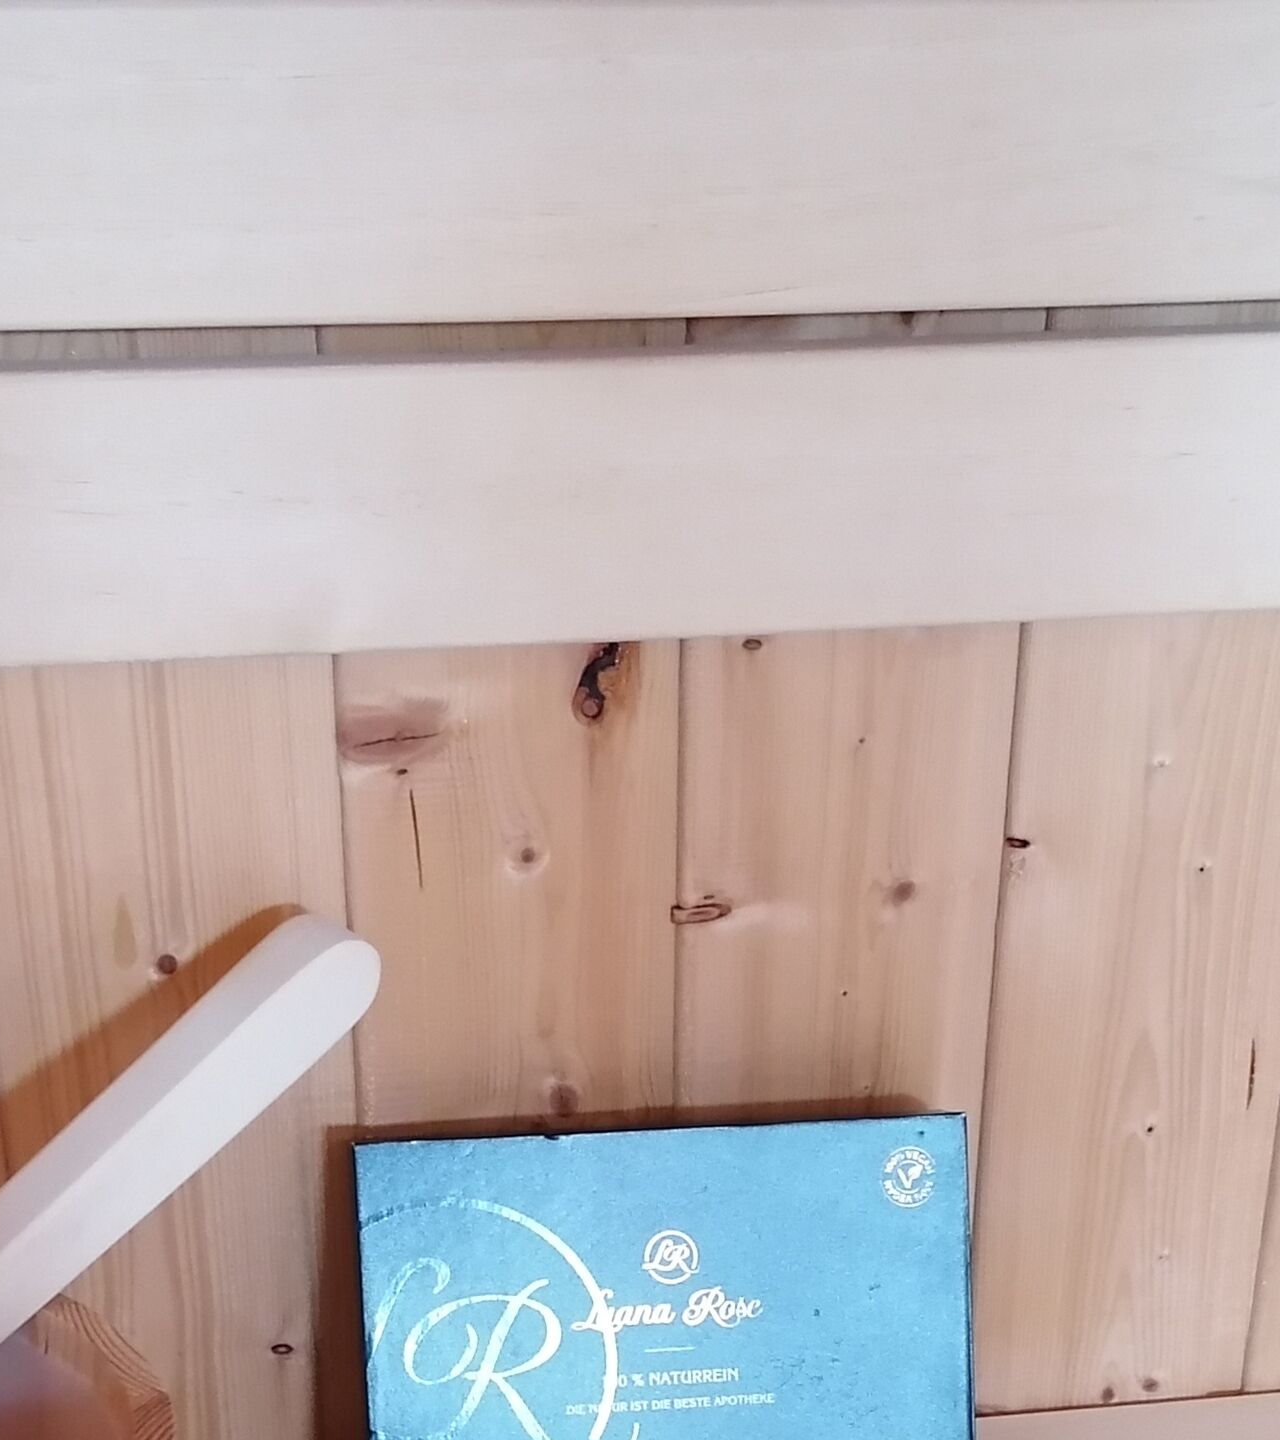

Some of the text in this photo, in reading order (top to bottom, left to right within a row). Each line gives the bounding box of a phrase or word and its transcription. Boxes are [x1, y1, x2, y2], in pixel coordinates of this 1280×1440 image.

[649, 1367, 739, 1387] NATURREIN
[566, 1393, 776, 1415] DIE NUR IST DIE BESTE APOTHEKE
